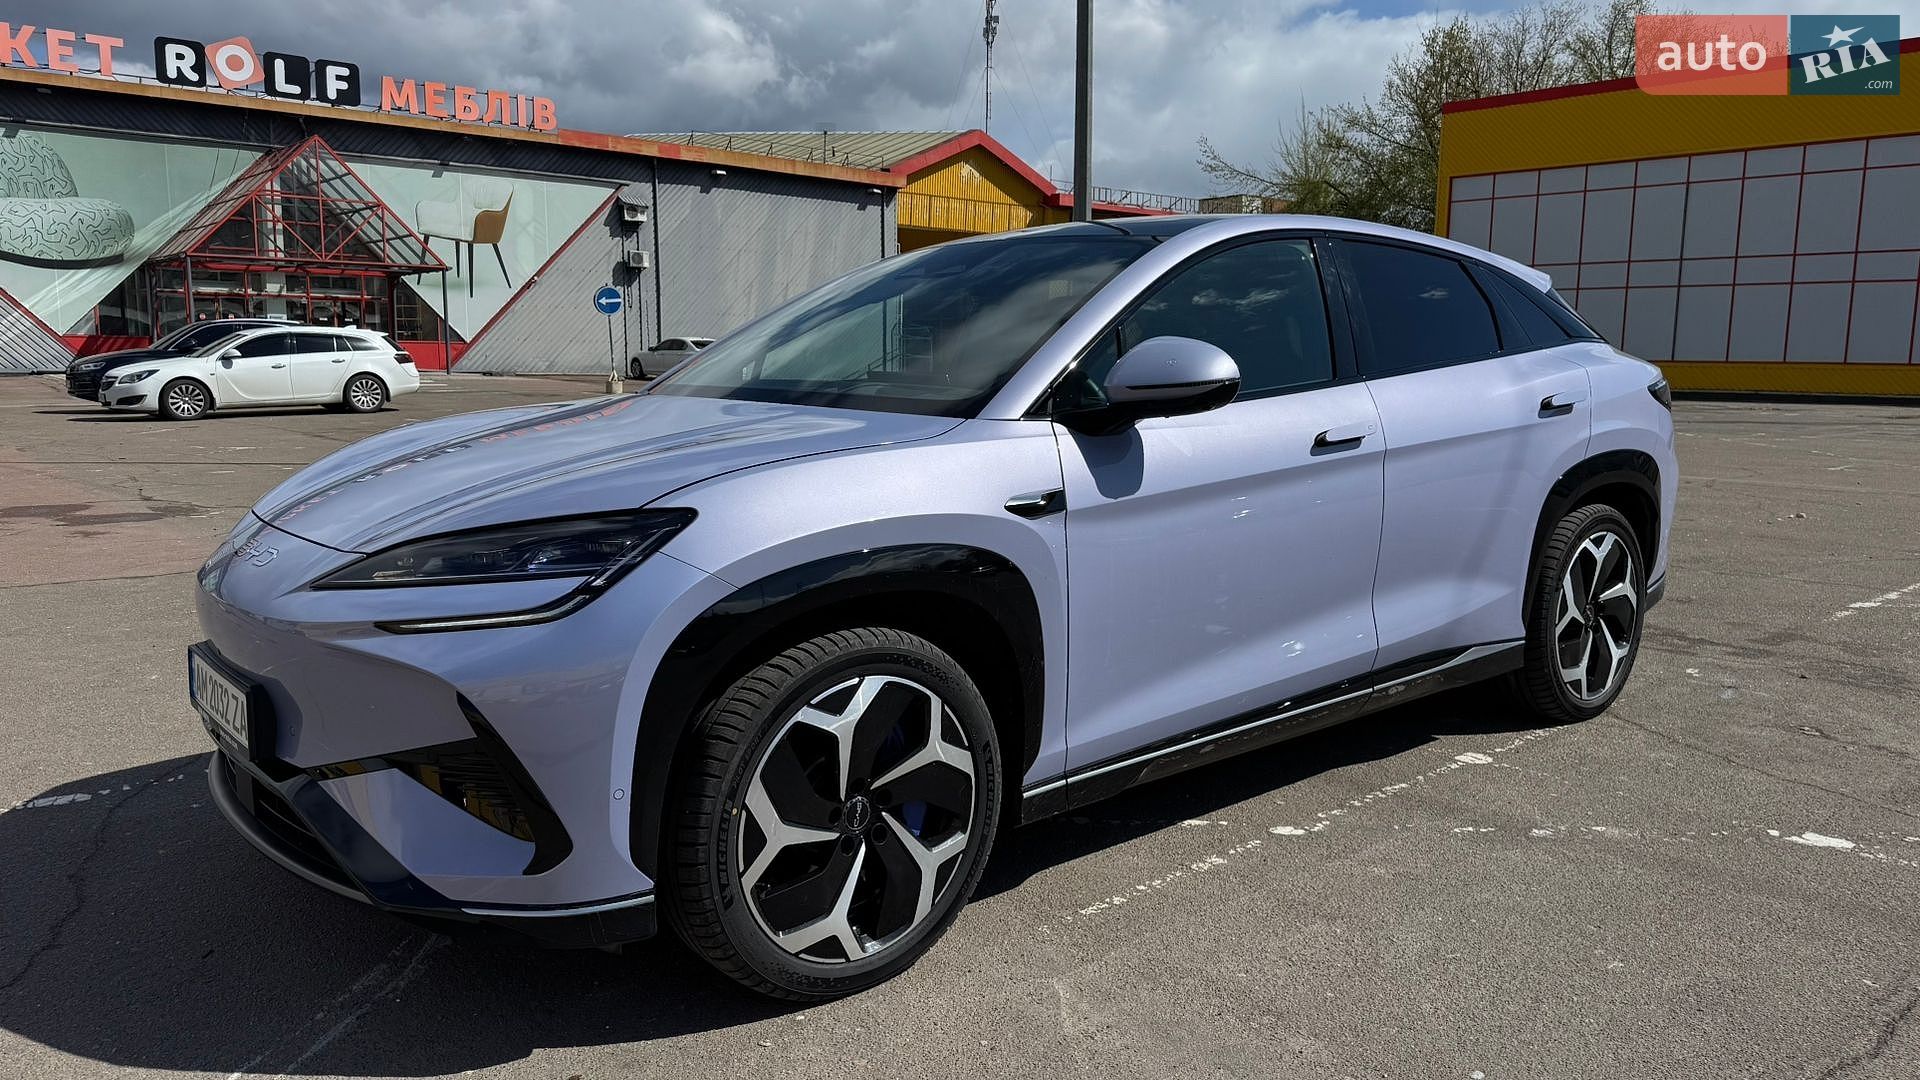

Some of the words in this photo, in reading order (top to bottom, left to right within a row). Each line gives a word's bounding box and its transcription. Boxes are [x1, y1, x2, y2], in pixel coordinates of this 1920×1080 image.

[0, 21, 124, 77] КЕТ
[164, 43, 351, 101] ROLF
[381, 75, 558, 131] МЕБЛІВ
[196, 662, 208, 706] AM
[208, 674, 231, 727] 2032
[231, 692, 249, 741] ZA
